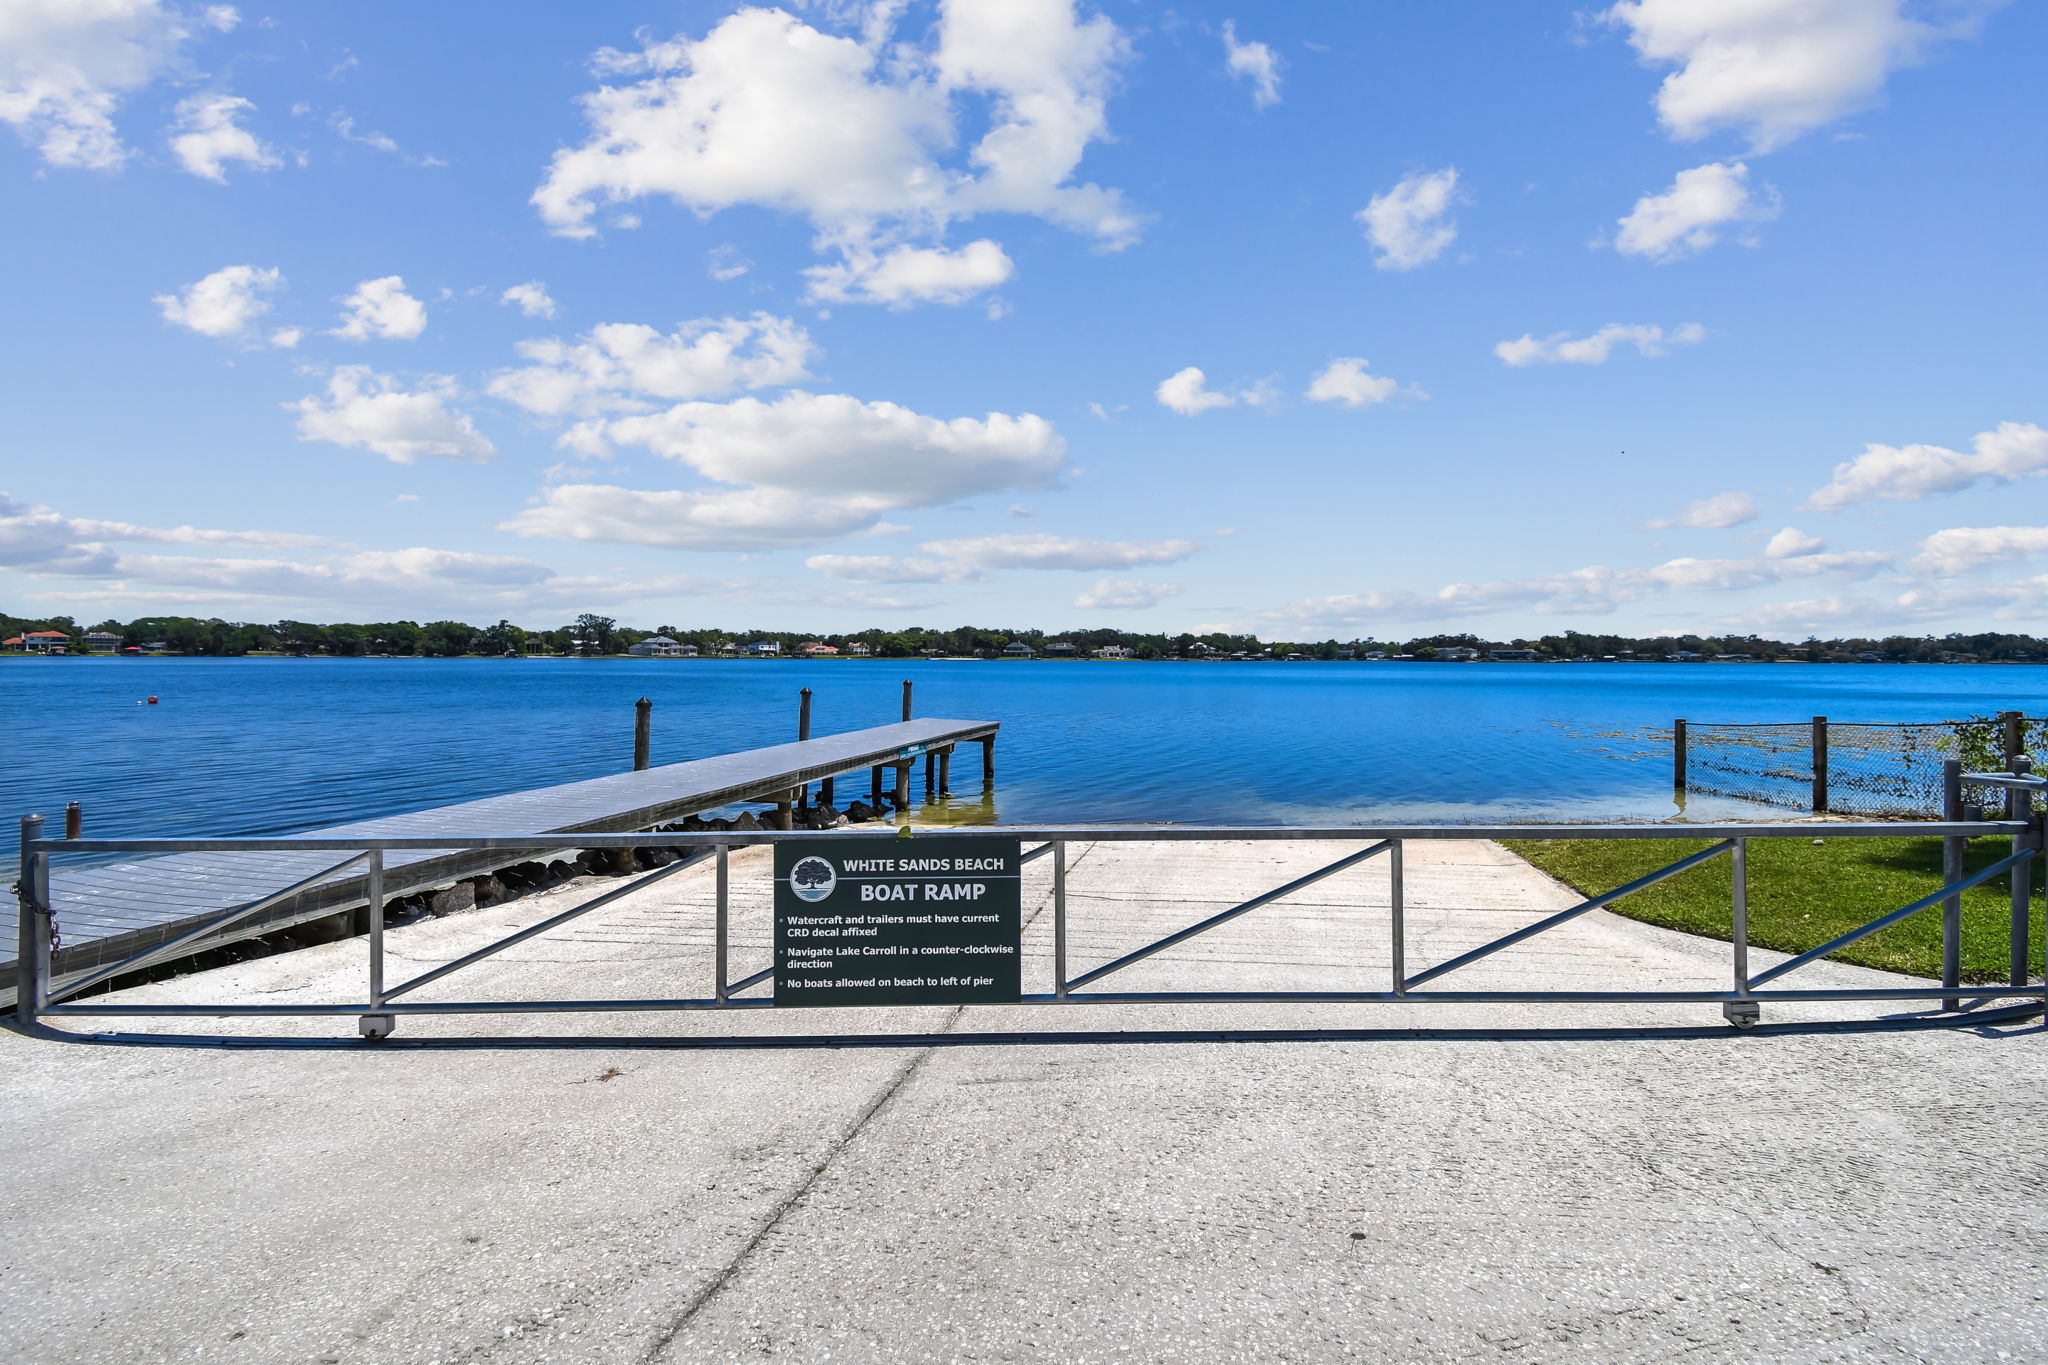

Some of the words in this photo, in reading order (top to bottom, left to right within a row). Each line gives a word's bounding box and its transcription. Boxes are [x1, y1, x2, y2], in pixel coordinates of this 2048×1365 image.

[843, 860, 894, 871] WHITE
[899, 859, 950, 871] SANDS
[955, 858, 1003, 870] BEACH
[861, 884, 918, 901] BOAT
[925, 884, 985, 900] RAMP
[787, 915, 843, 925] Watercraft
[845, 915, 864, 924] and
[867, 915, 903, 923] trailers
[907, 915, 932, 923] must
[935, 914, 959, 922] have
[962, 914, 999, 922] current
[788, 929, 809, 937] CRD
[812, 928, 839, 936] decal
[842, 927, 877, 936] affixed
[788, 947, 833, 958] Navigate
[836, 947, 860, 955] Lake
[863, 946, 896, 955] Carroll
[900, 946, 909, 955] in
[911, 947, 918, 955] a
[921, 945, 1013, 954] counter-clockwise
[787, 959, 832, 968] direction
[788, 980, 801, 989] No
[805, 979, 833, 987] boats
[836, 978, 875, 987] allowed
[878, 979, 891, 987] on
[894, 977, 924, 986] beach
[927, 978, 937, 987] to
[941, 977, 958, 985] left
[961, 977, 971, 986] of
[974, 976, 993, 987] pier
